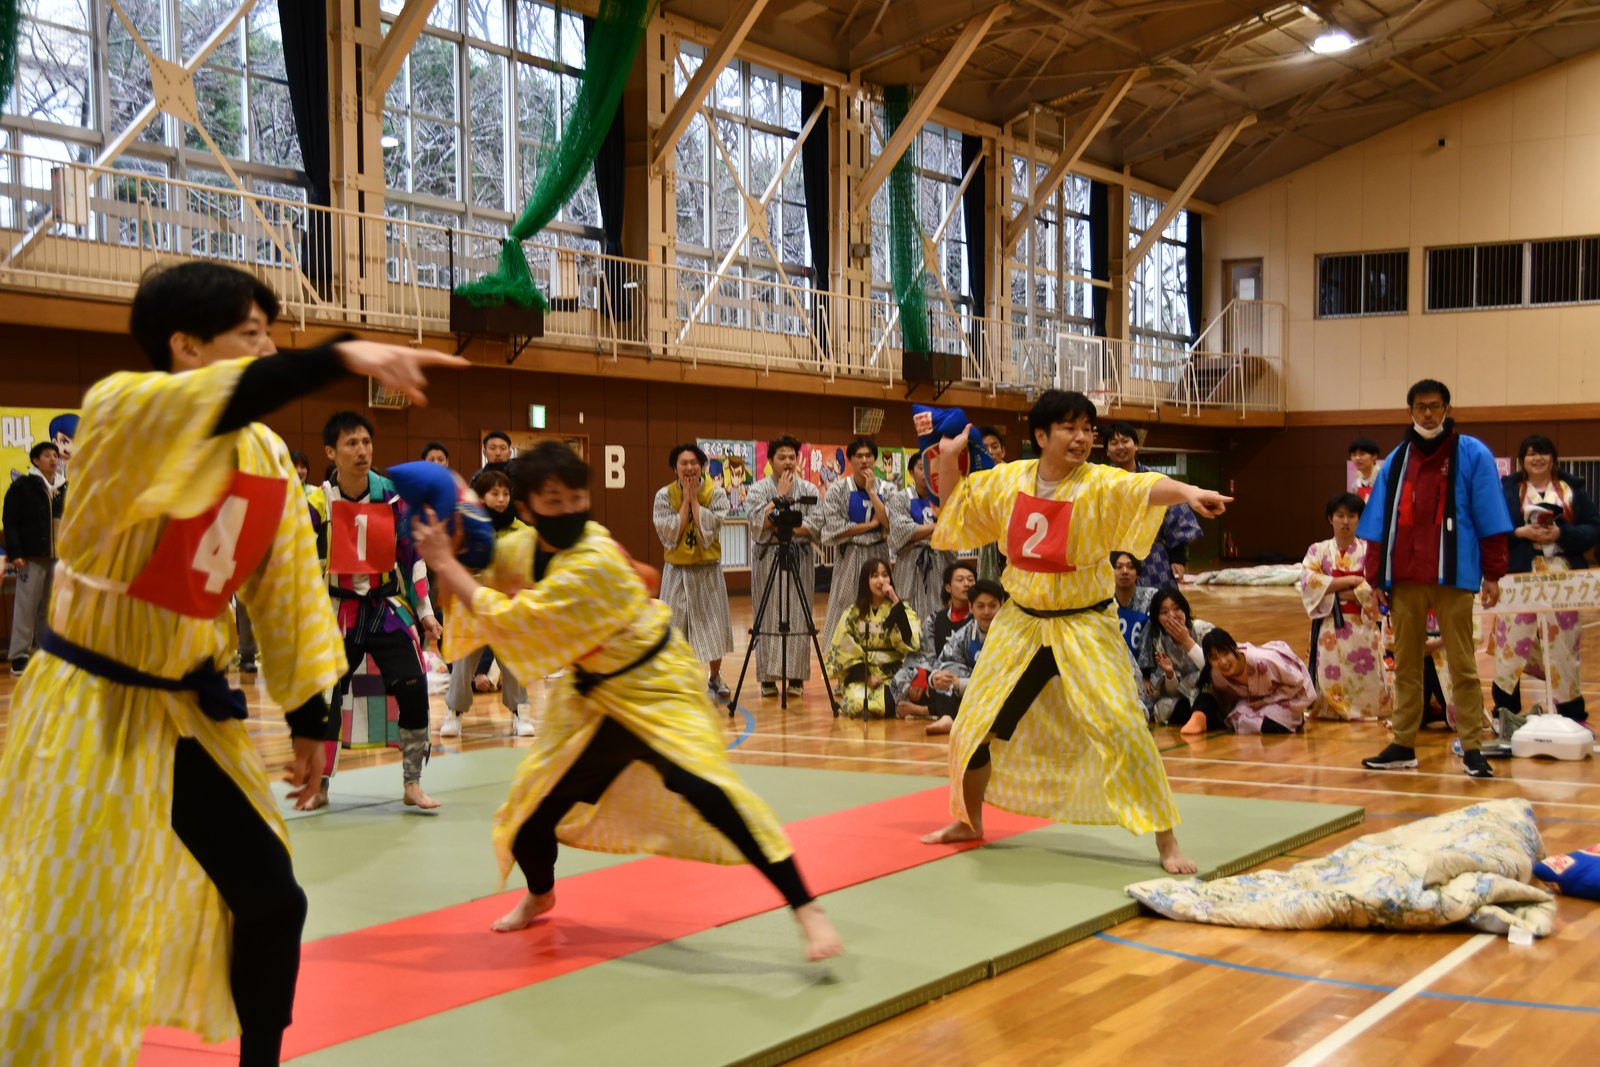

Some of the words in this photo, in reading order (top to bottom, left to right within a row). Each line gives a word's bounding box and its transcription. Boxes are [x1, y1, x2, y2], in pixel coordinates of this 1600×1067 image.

[605, 445, 625, 489] B
[191, 495, 249, 594] 4
[354, 513, 368, 562] 1
[1022, 512, 1049, 558] 2
